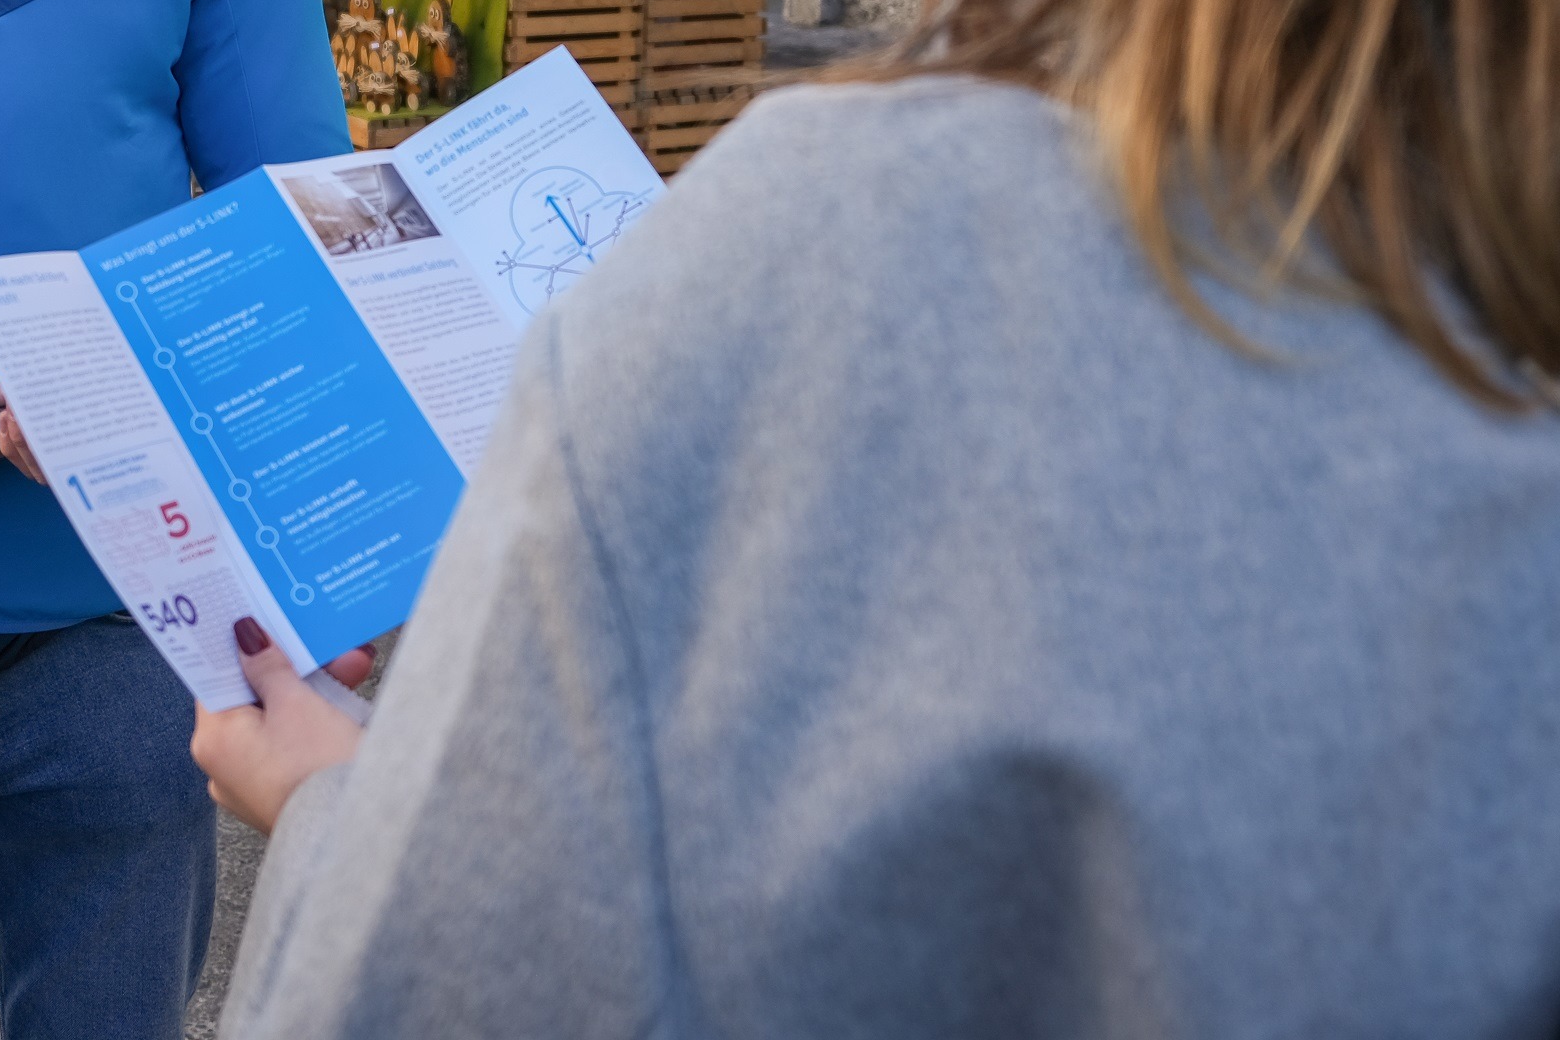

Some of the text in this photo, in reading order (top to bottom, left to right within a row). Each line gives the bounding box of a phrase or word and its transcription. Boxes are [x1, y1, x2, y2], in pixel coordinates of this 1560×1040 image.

[415, 102, 512, 165] Der S-LINK fährt da,
[425, 106, 530, 177] wo die Menschen sind
[100, 200, 239, 272] Was bringt uns der S-LINK?
[156, 259, 186, 278] S-LINK
[191, 321, 223, 341] S-LINK
[67, 473, 94, 512] 1
[158, 499, 190, 539] 5
[141, 593, 197, 633] 540
